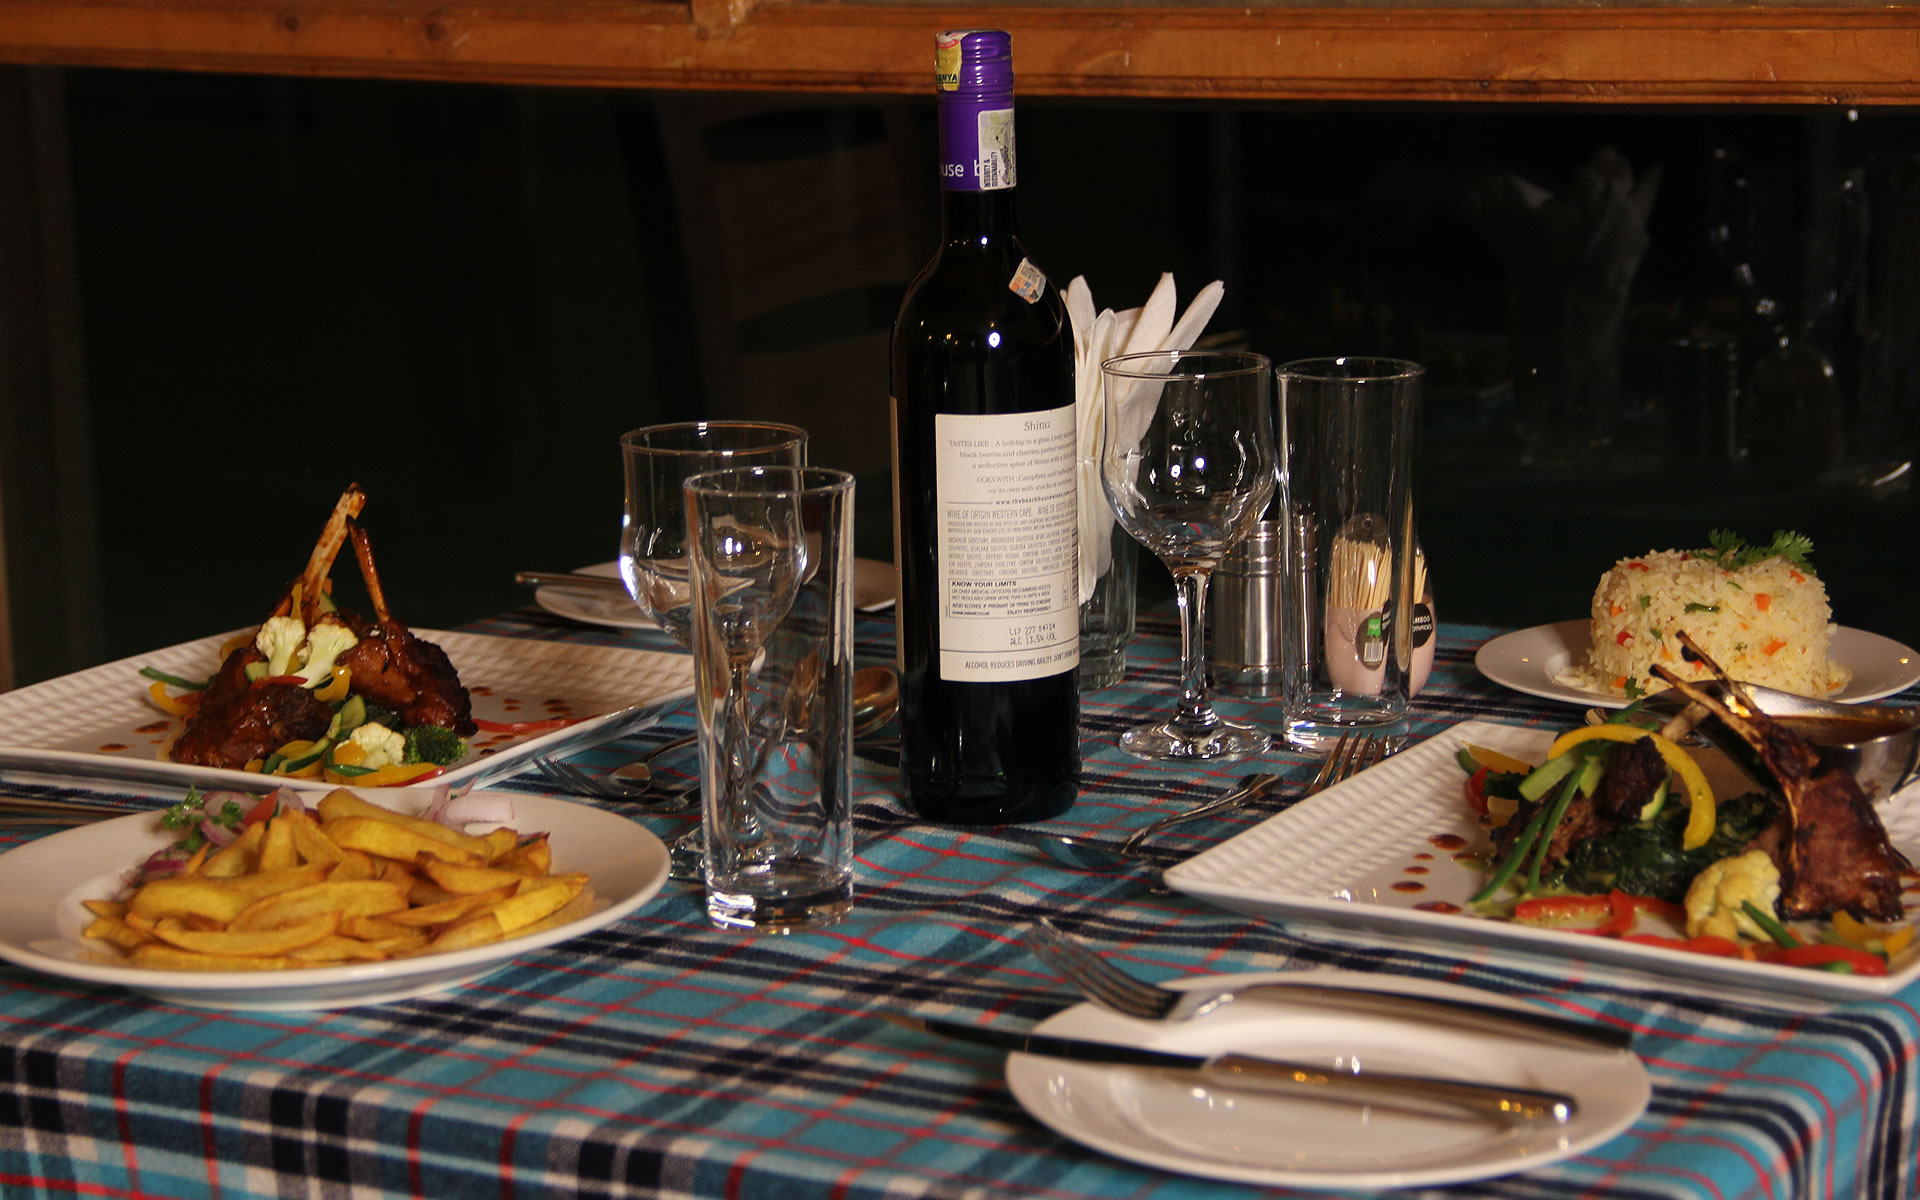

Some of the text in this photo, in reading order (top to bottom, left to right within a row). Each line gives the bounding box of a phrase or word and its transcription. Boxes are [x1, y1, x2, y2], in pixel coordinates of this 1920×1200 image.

[1024, 421, 1052, 432] Shiraz
[948, 440, 973, 448] TASTES
[979, 450, 1001, 458] berries
[976, 475, 996, 483] GOES
[947, 509, 960, 519] WINE
[961, 510, 969, 519] OF
[970, 509, 991, 520] ORIGIN
[992, 507, 1018, 520] WESTERN
[1019, 506, 1032, 518] CAPE
[965, 661, 989, 669] ALCOHOL
[990, 660, 1015, 669] REDUCES
[1016, 658, 1036, 667] DRIVING
